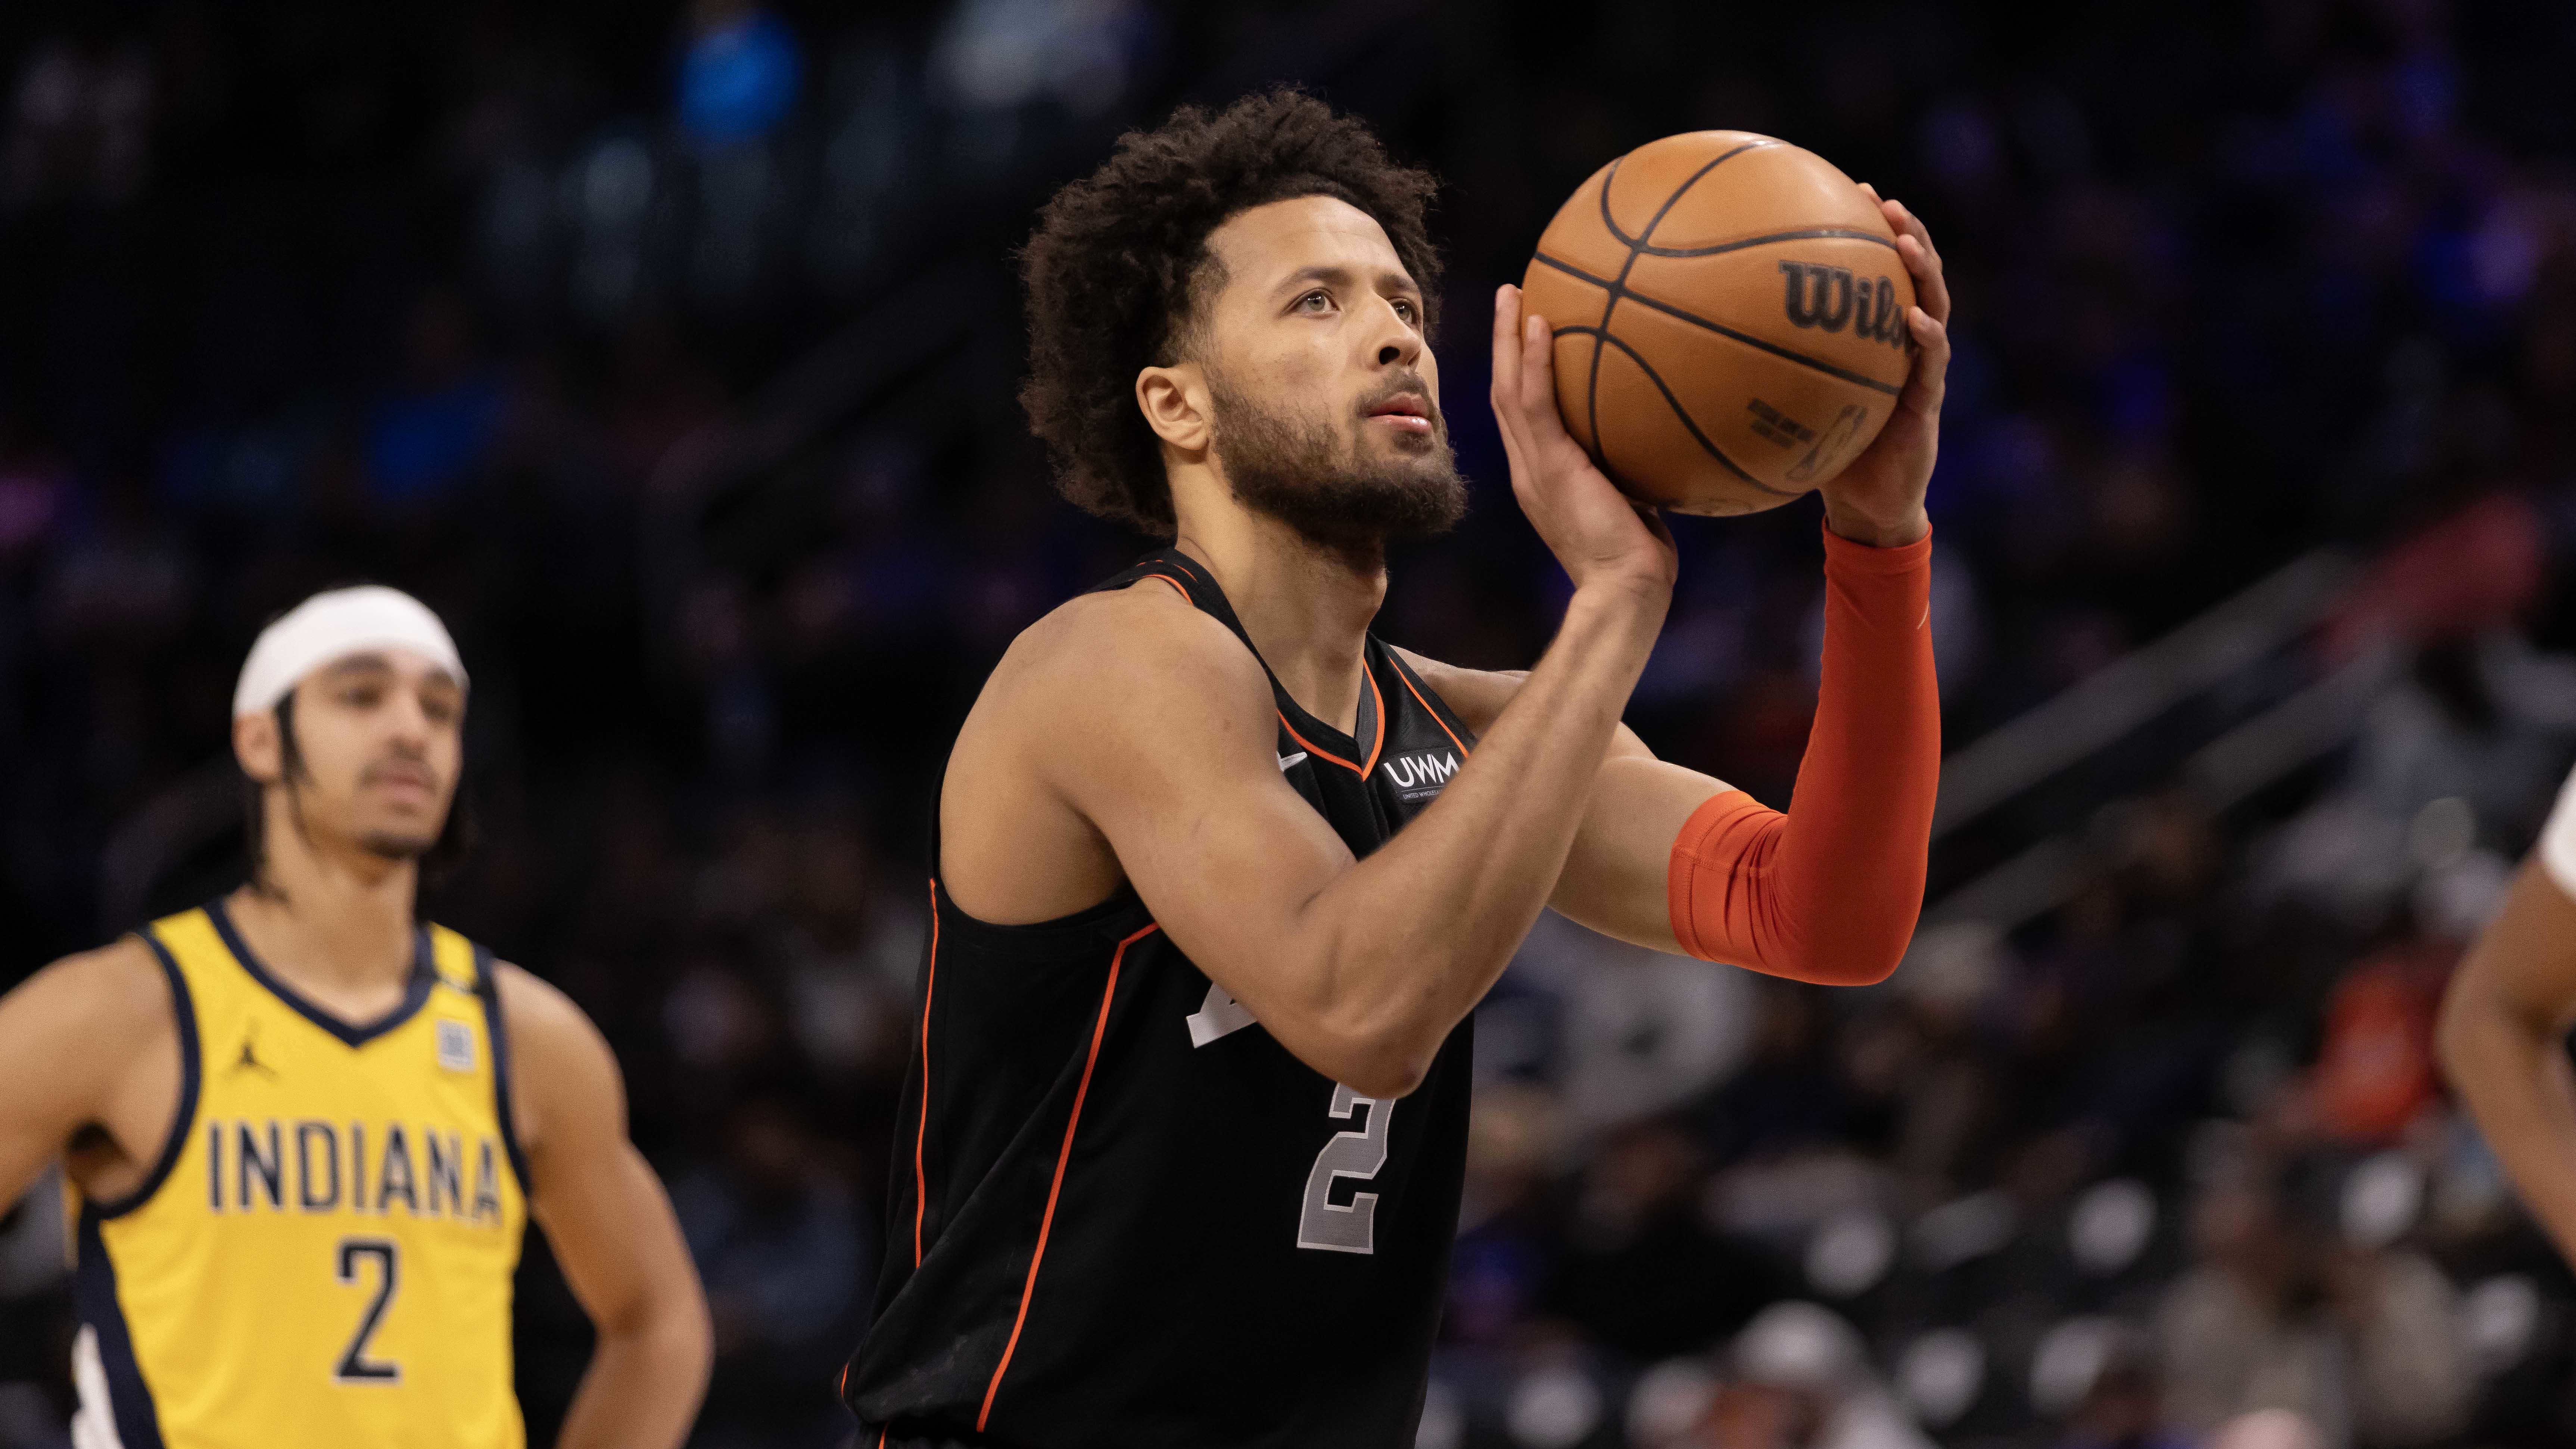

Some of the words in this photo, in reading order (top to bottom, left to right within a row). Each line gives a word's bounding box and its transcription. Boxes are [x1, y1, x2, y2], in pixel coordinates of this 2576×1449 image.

[1778, 260, 1910, 351] Wils
[1383, 751, 1460, 787] UWM
[207, 1118, 503, 1228] INDIANA
[1297, 1082, 1397, 1255] 2
[334, 1237, 402, 1387] 2
